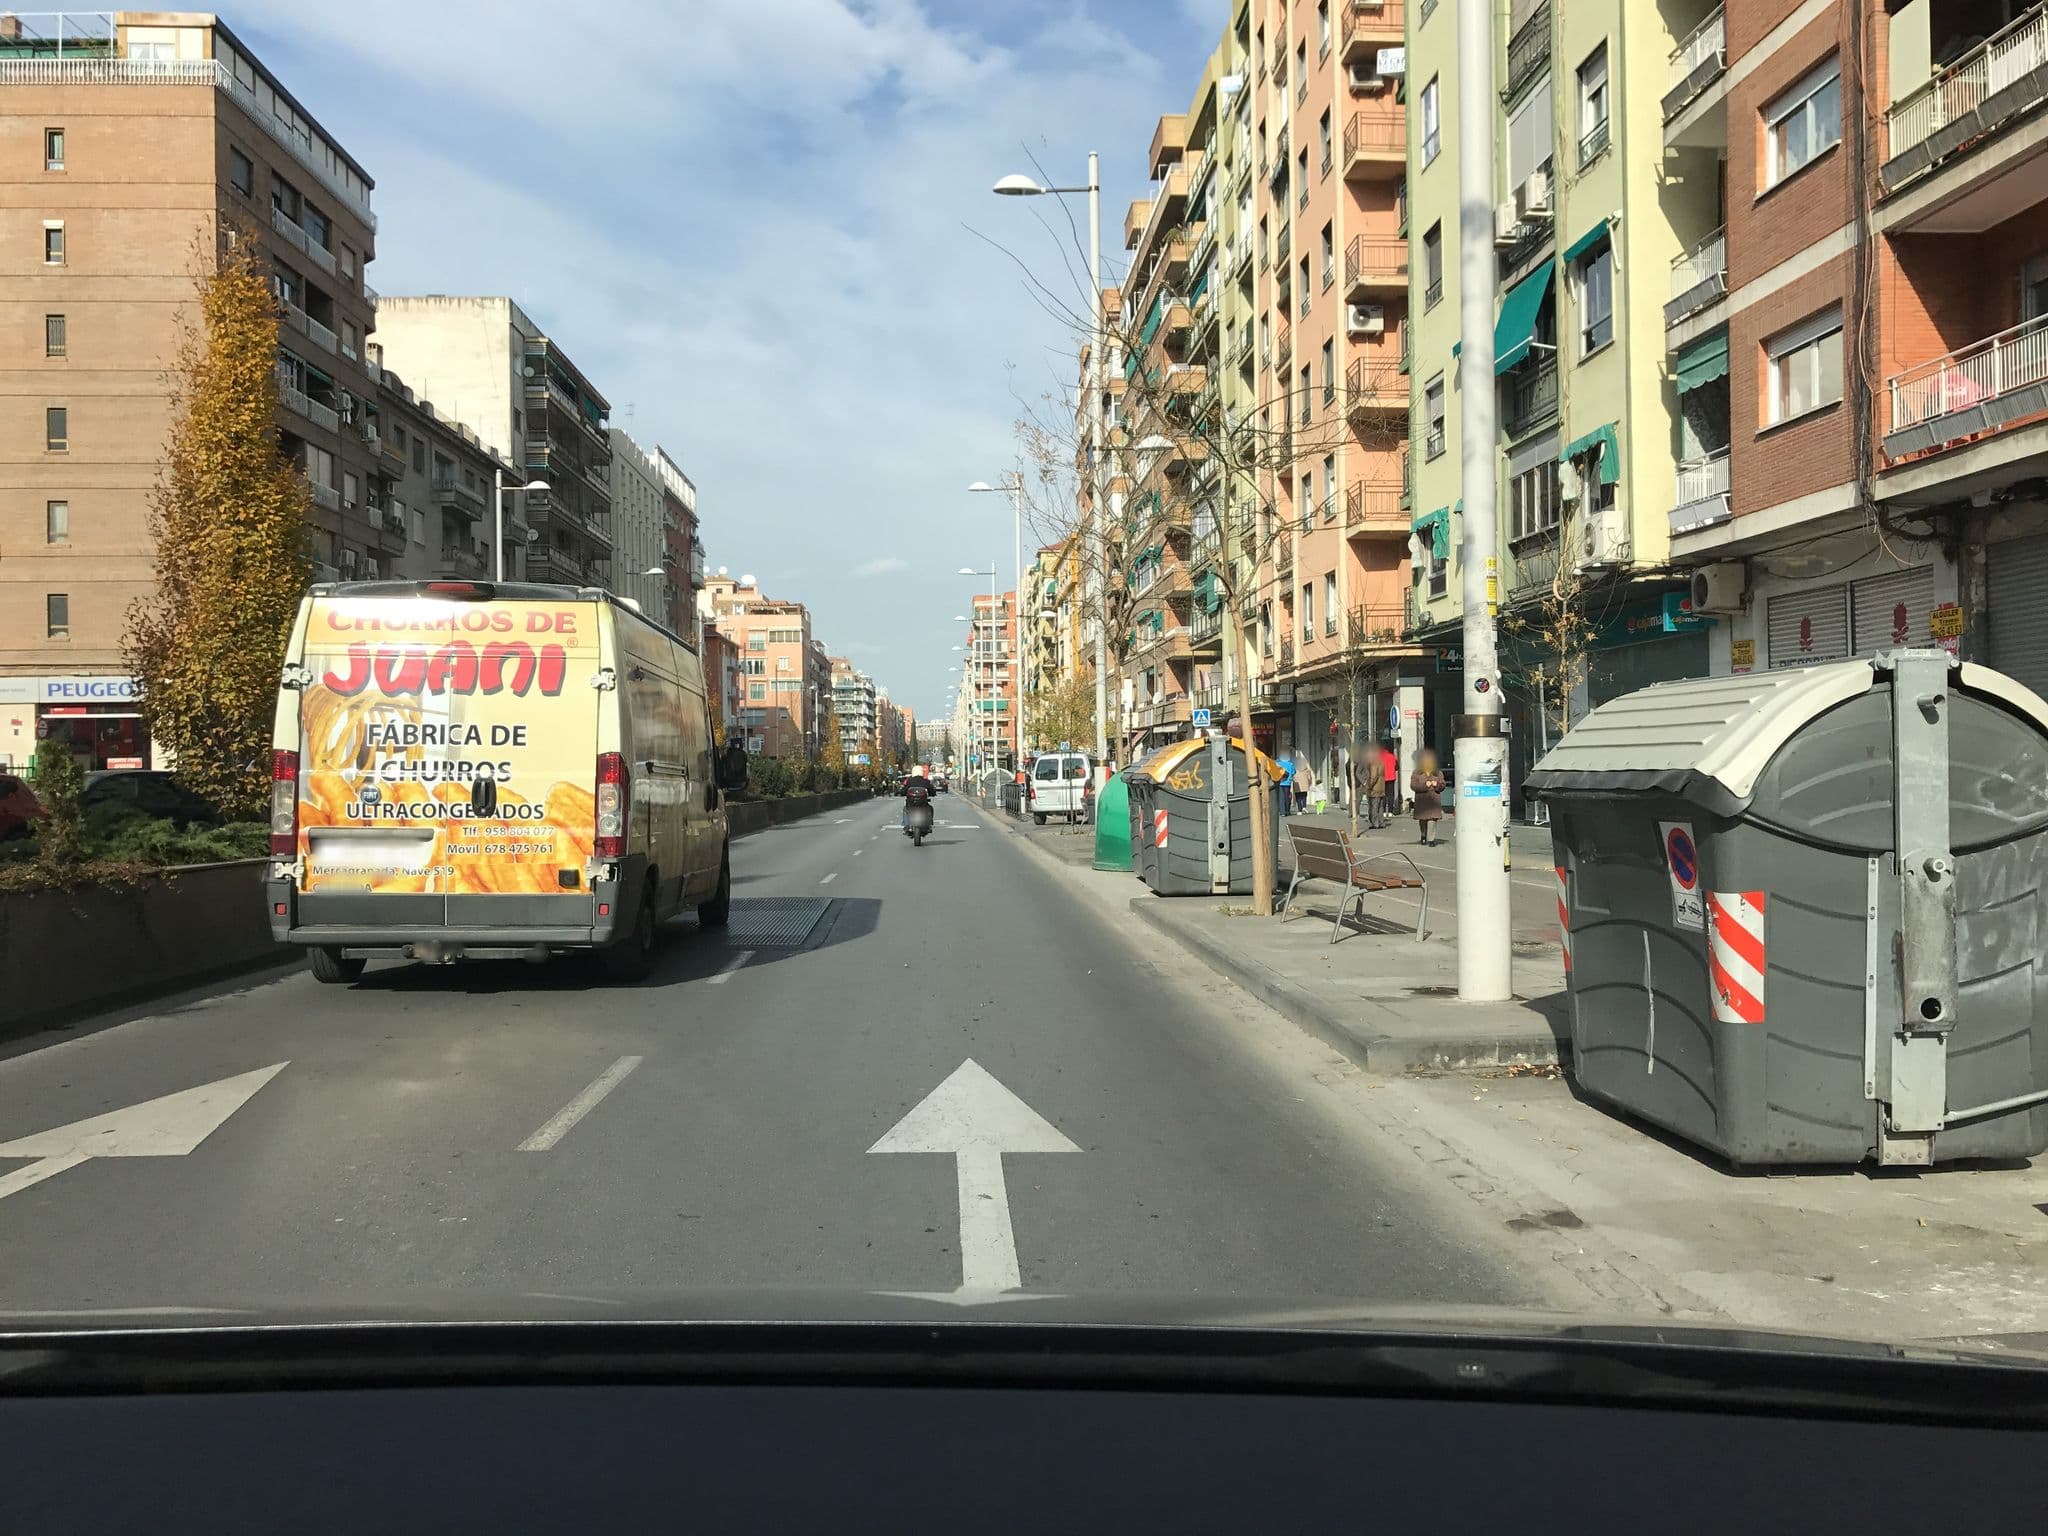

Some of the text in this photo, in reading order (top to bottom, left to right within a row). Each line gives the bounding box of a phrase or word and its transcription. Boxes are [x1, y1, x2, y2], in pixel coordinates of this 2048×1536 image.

[526, 612, 577, 633] DE
[48, 682, 135, 697] PEUGEO
[368, 719, 527, 746] FÁBRICA DE
[381, 761, 512, 782] CHURROS
[347, 803, 544, 819] ULTRACONGEADOS
[485, 827, 506, 836] 958
[533, 827, 554, 836] 077
[485, 844, 506, 853] 678
[509, 844, 530, 853] 475
[533, 844, 553, 853] 761
[402, 866, 431, 875] Nave
